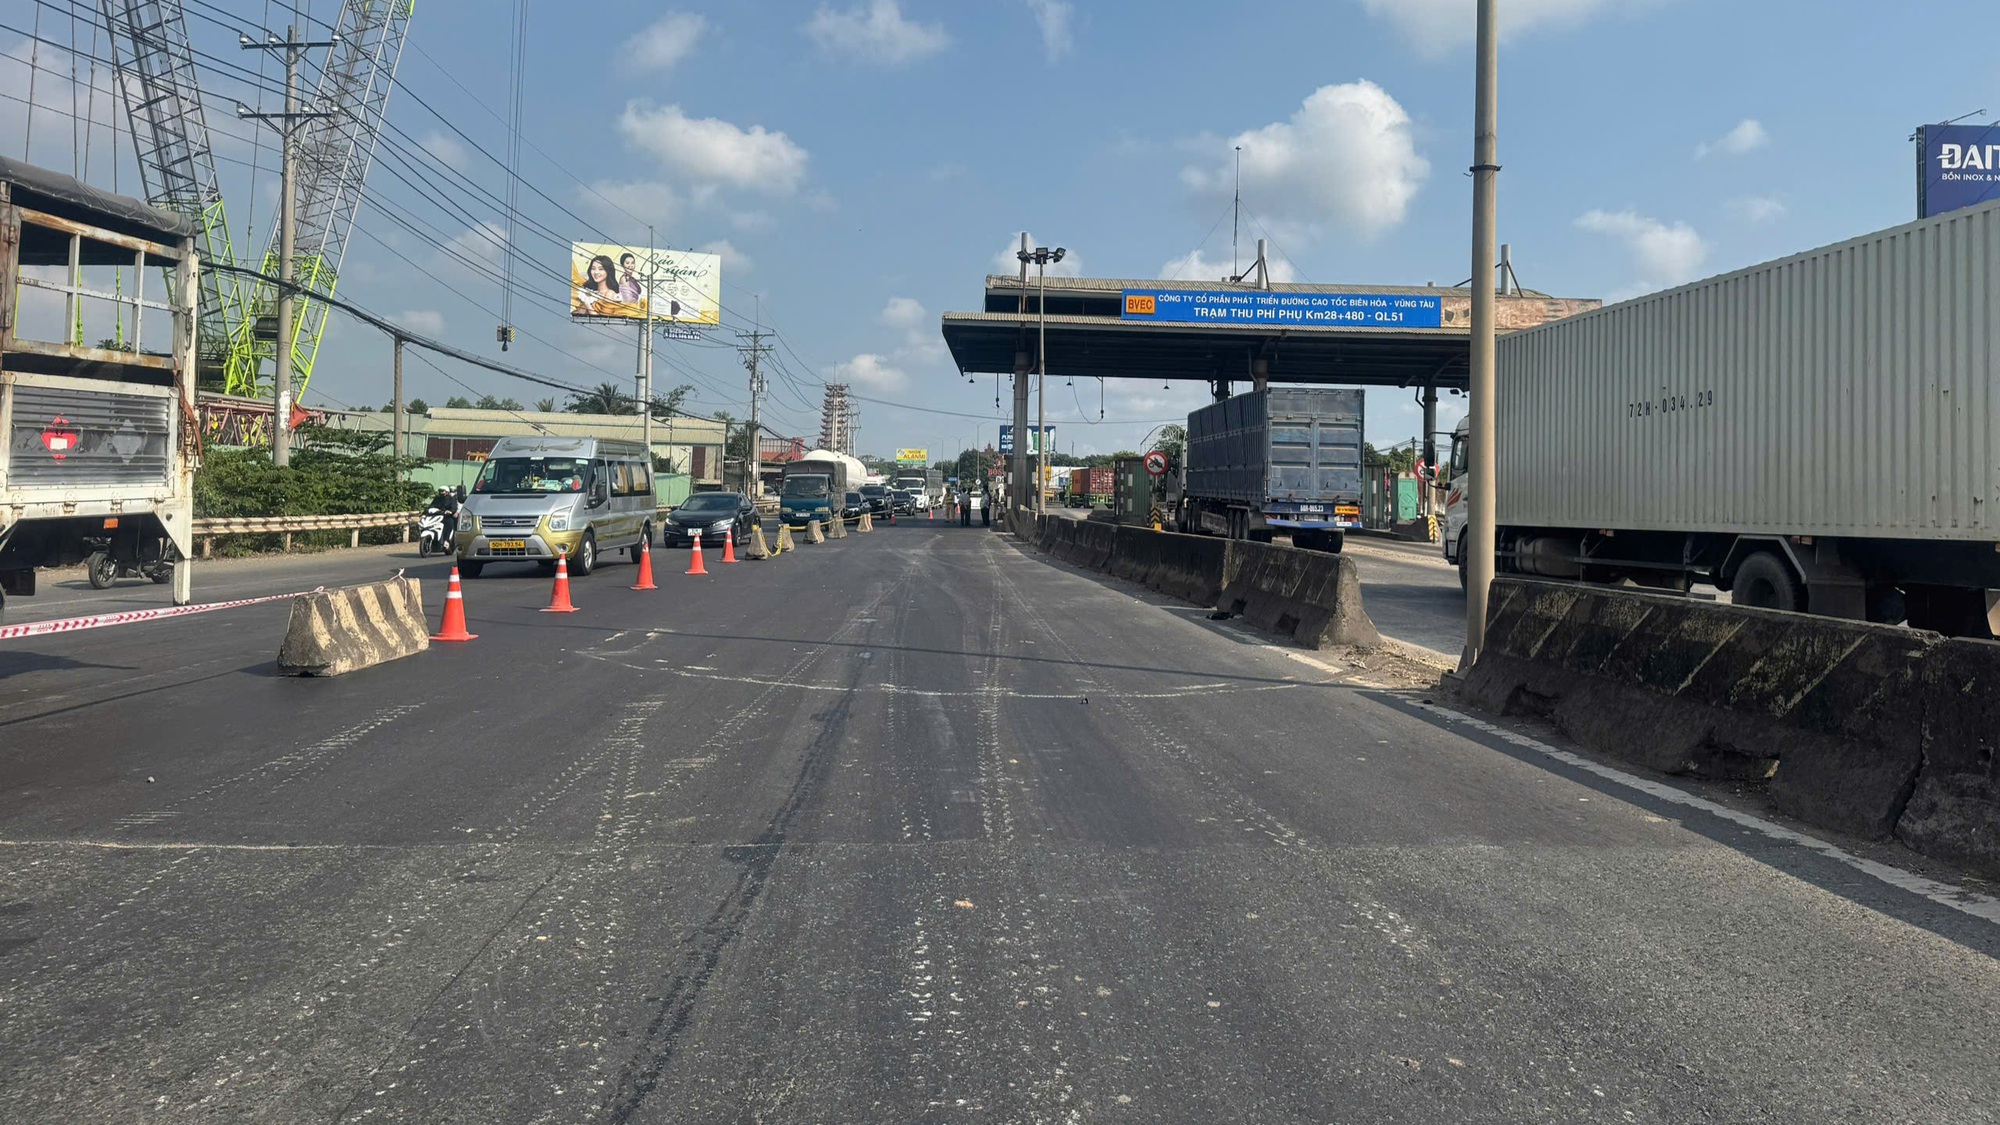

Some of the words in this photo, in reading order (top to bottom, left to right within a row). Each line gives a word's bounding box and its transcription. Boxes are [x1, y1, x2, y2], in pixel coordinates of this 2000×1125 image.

[1963, 173, 1984, 181] INOX
[1127, 299, 1153, 310] BVEC
[1158, 293, 1181, 303] CÔNG
[1183, 295, 1193, 303] TY
[1195, 292, 1207, 304] CỔ
[1209, 293, 1230, 304] PHẦN
[1232, 295, 1253, 305] PHÁT
[1256, 294, 1279, 306] TRIỂN
[1281, 297, 1310, 306] ĐƯỜNG
[1311, 298, 1329, 306] CAO
[1330, 296, 1347, 307] TỐC
[1349, 298, 1368, 307] BIÊN
[1394, 298, 1417, 308] VŨNG
[1419, 299, 1435, 309] TÀU
[1193, 307, 1227, 319] TRẠM
[1230, 308, 1253, 319] THU
[1256, 308, 1275, 319] PHÍ
[1278, 309, 1303, 322] PHỤ
[1305, 310, 1365, 321] Km28+480
[1374, 311, 1404, 322] QL51
